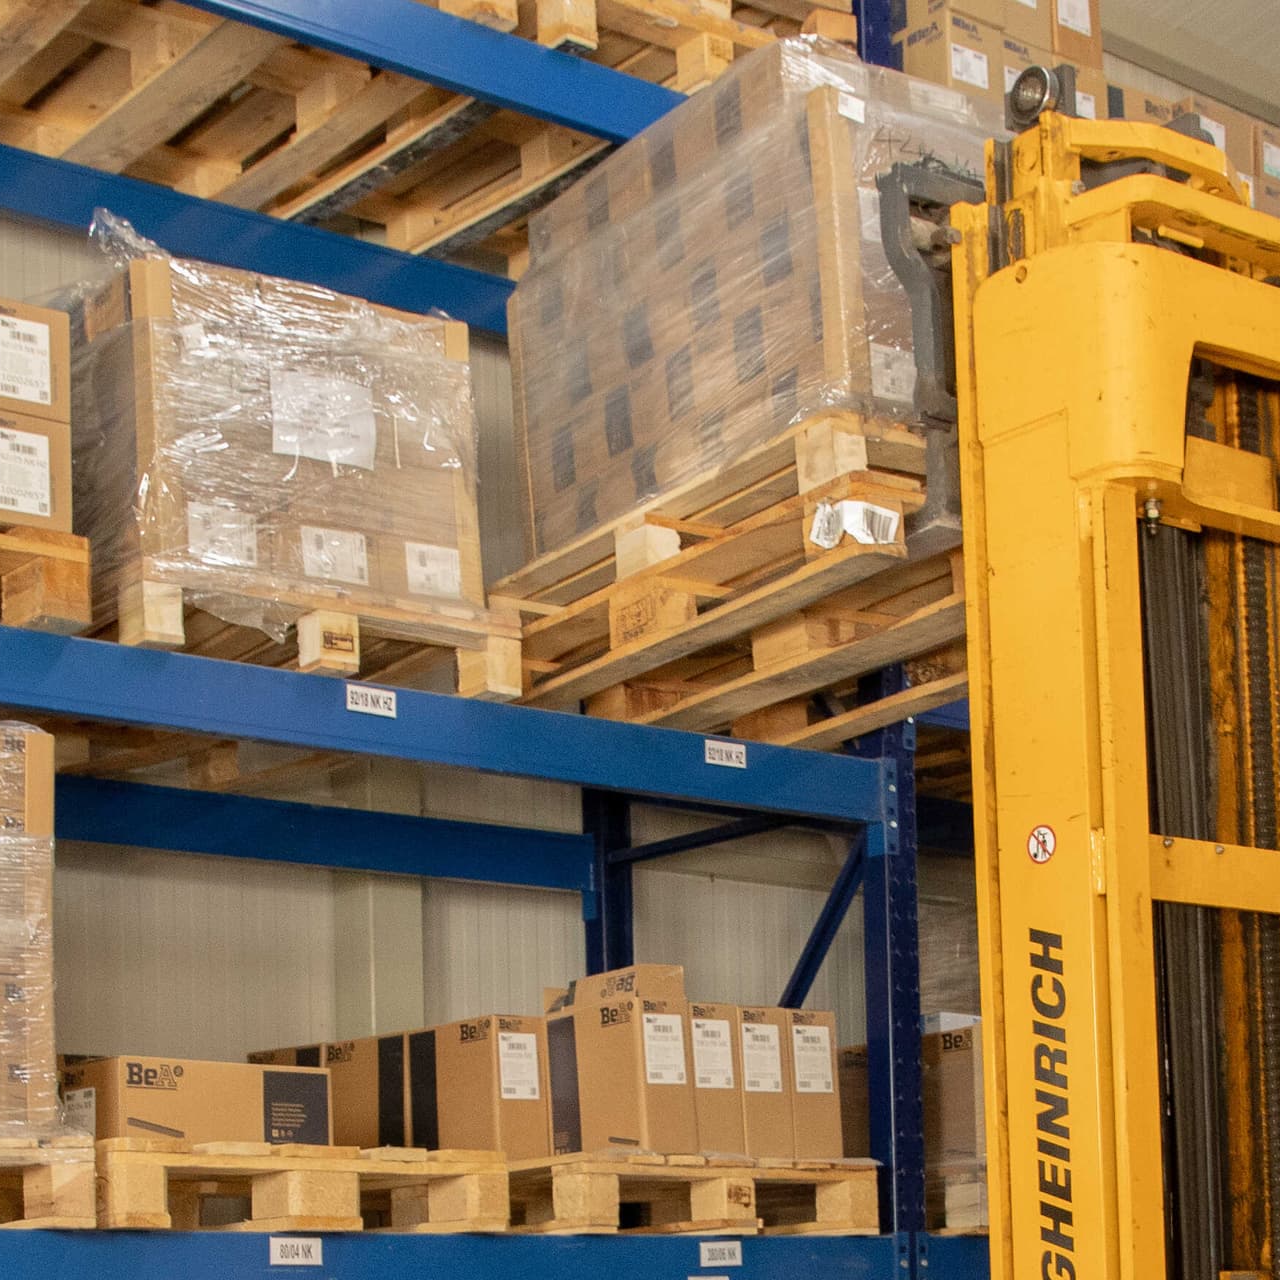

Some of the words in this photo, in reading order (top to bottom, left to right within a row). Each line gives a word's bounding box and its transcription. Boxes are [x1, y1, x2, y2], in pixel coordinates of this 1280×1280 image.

[370, 694, 382, 709] NK
[383, 696, 392, 711] HZ
[126, 1063, 180, 1088] BeA
[302, 1244, 312, 1259] NK
